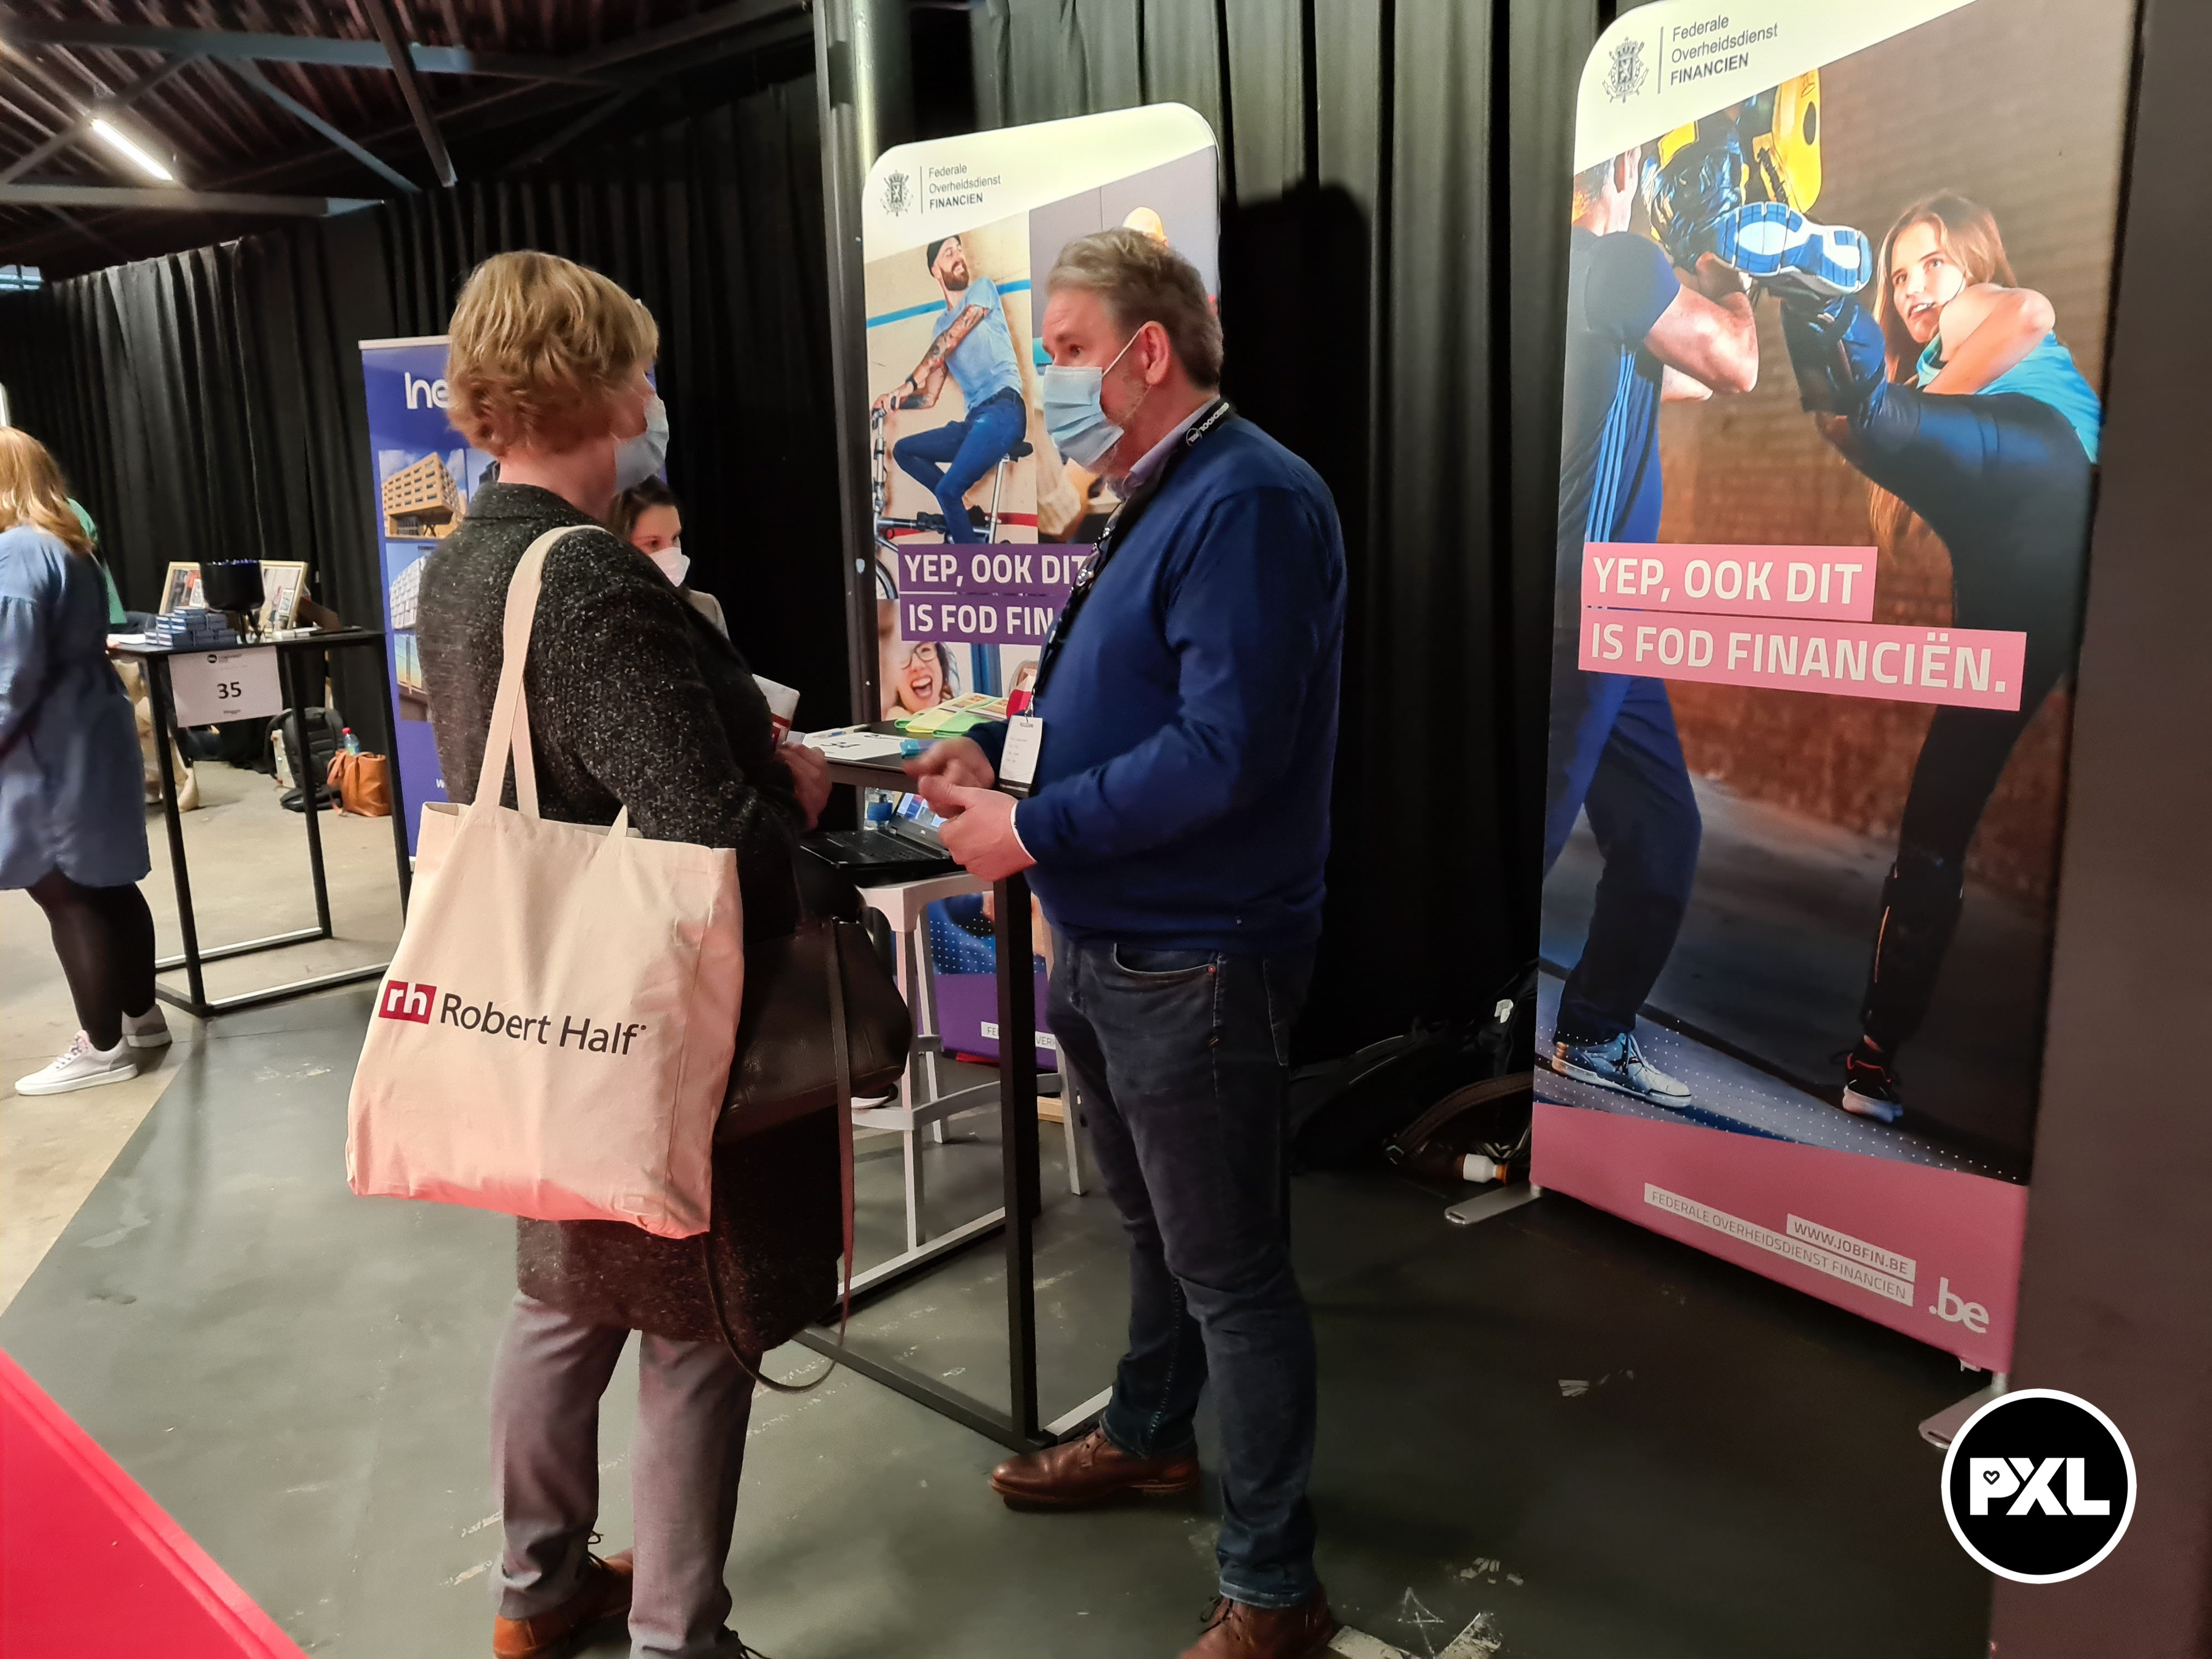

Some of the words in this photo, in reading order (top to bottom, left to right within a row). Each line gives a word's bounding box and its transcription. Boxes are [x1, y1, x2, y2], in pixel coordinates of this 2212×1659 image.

[1672, 22, 1778, 63] Overheidsdienst
[1673, 15, 1729, 42] Federale
[1671, 53, 1749, 86] FINANCIEN
[929, 163, 967, 178] Federale
[929, 174, 1001, 193] Overheidsdienst
[930, 193, 983, 209] FINANCIEN
[904, 554, 963, 587] YEP,
[971, 554, 1032, 583] OOK
[1593, 557, 1671, 602] YEP,
[1684, 560, 1773, 601] OOK
[1786, 562, 1863, 604] DIT
[909, 603, 933, 632] IS
[941, 605, 997, 634] FOD
[1592, 623, 1623, 659] IS
[1635, 625, 1713, 667] FOD
[1728, 631, 2006, 693] FINANCIËN.
[217, 681, 241, 699] 35
[386, 983, 428, 1016] rh
[441, 993, 551, 1045] Robert
[988, 1027, 998, 1036] FE
[1652, 1191, 1709, 1222] FEDERALE
[1713, 1215, 1829, 1267] OVERHEIDSDIENST
[1832, 1261, 1906, 1299] FINANCIEN
[1795, 1222, 1908, 1275] WWW.JOBFIN.BE
[1929, 1277, 1989, 1333] .be
